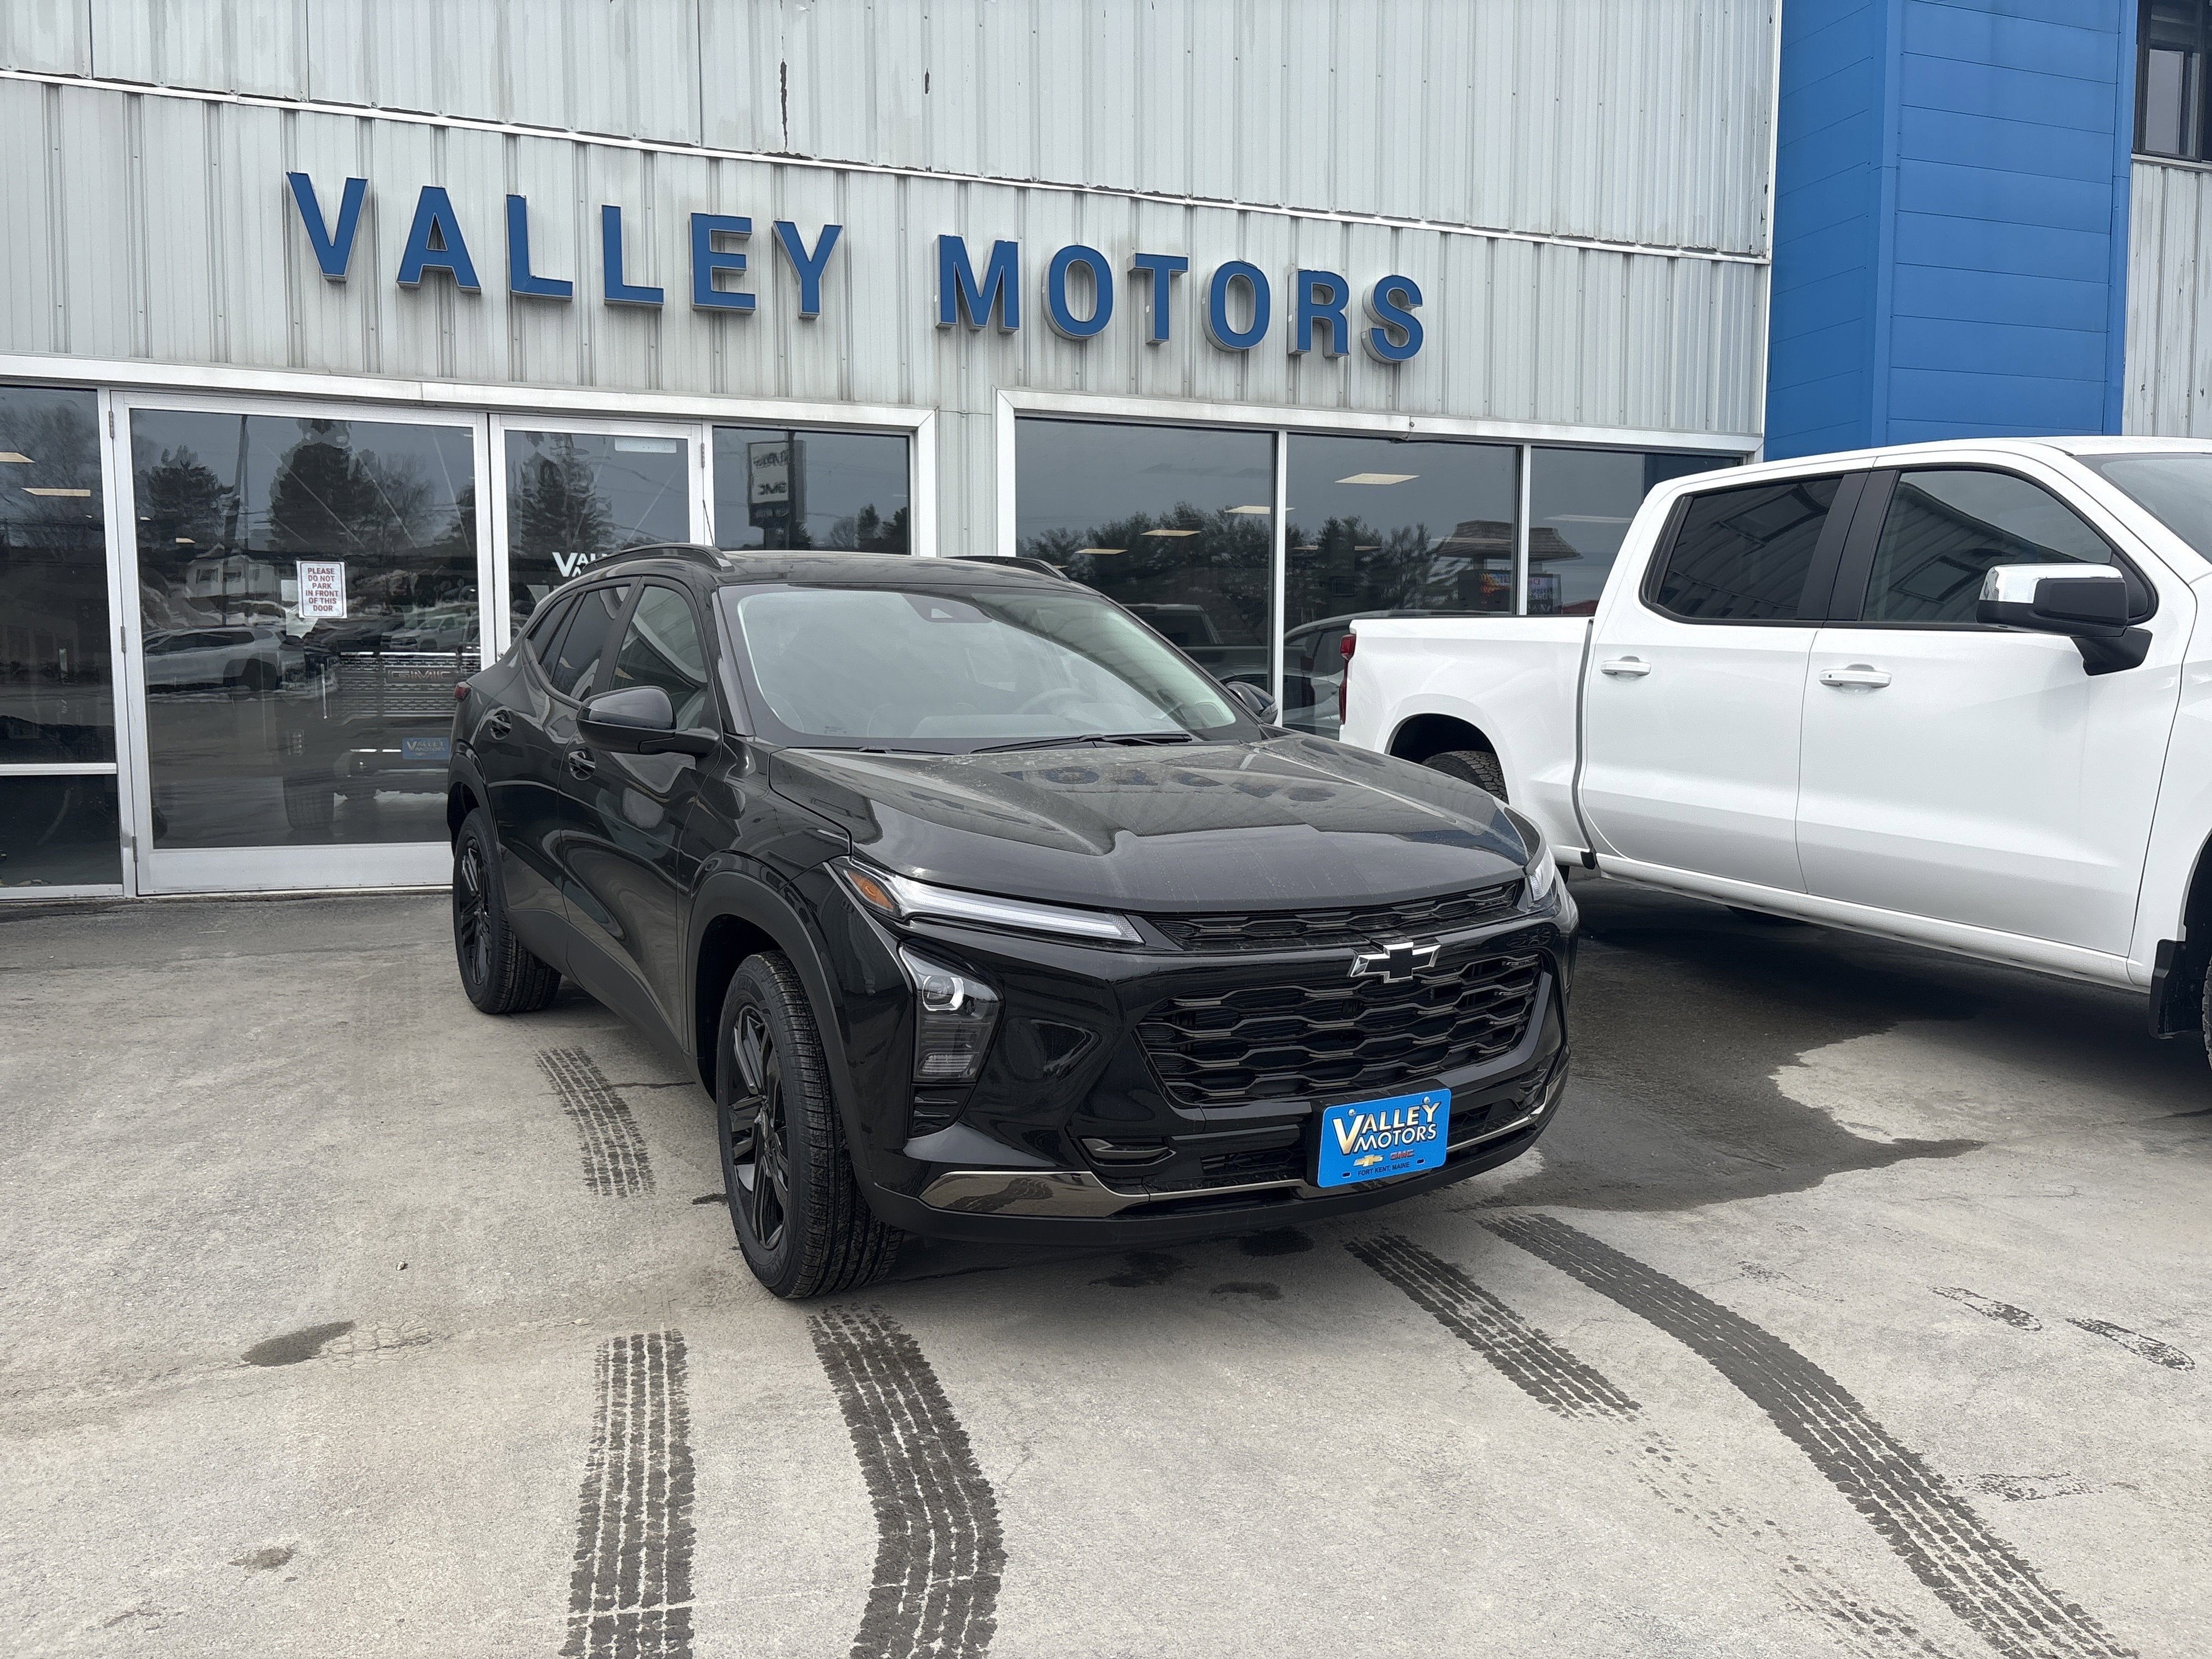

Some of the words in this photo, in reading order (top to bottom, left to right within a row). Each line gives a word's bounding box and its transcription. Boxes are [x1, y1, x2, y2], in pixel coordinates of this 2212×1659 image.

[286, 171, 843, 319] VALLEY
[935, 234, 1424, 364] MOTORS
[552, 551, 607, 577] VAL
[388, 670, 451, 680] GMC
[1332, 1102, 1441, 1155] VALLEY
[1353, 1124, 1437, 1153] MOTORS
[1358, 1168, 1374, 1176] FORT
[1374, 1165, 1391, 1173] KENT,
[1392, 1161, 1410, 1170] MAINE
